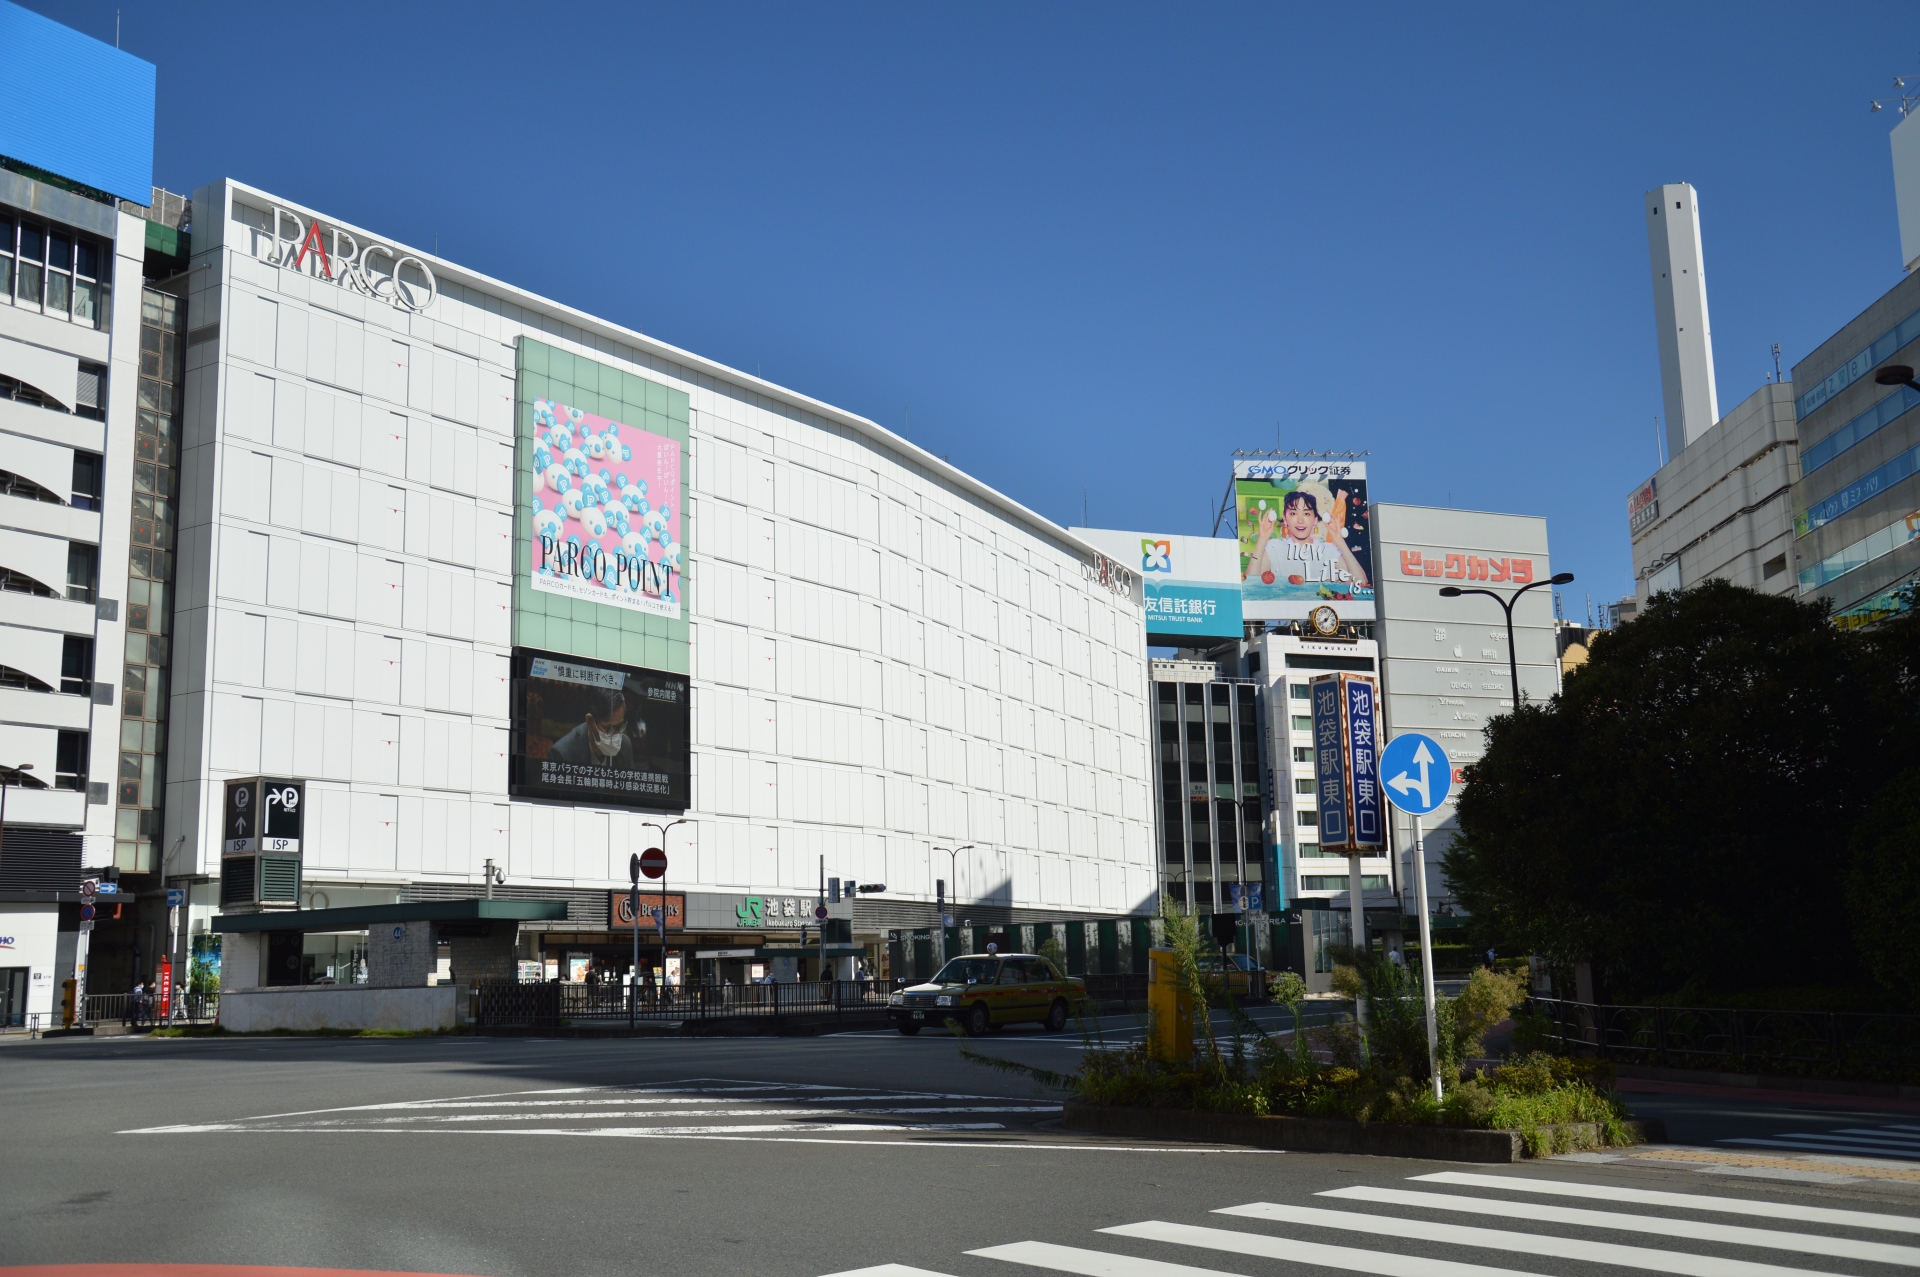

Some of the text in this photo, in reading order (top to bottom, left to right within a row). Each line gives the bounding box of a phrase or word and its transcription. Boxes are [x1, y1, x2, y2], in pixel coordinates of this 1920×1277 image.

[271, 205, 437, 310] PARCO
[1287, 543, 1326, 561] new
[541, 535, 673, 597] PARCO POINT
[1093, 551, 1132, 598] PARCO
[1400, 550, 1534, 584] ビックカメラ
[1318, 689, 1342, 834] 池袋駅東口
[1352, 690, 1376, 834] 池袋駅東口
[234, 840, 246, 851] ISP
[272, 839, 288, 850] ISP
[641, 903, 679, 916] BER'S
[736, 896, 763, 918] JR
[765, 897, 812, 917] 池袋駅
[766, 919, 793, 927] Ikebukuro
[272, 936, 286, 946] ISP
